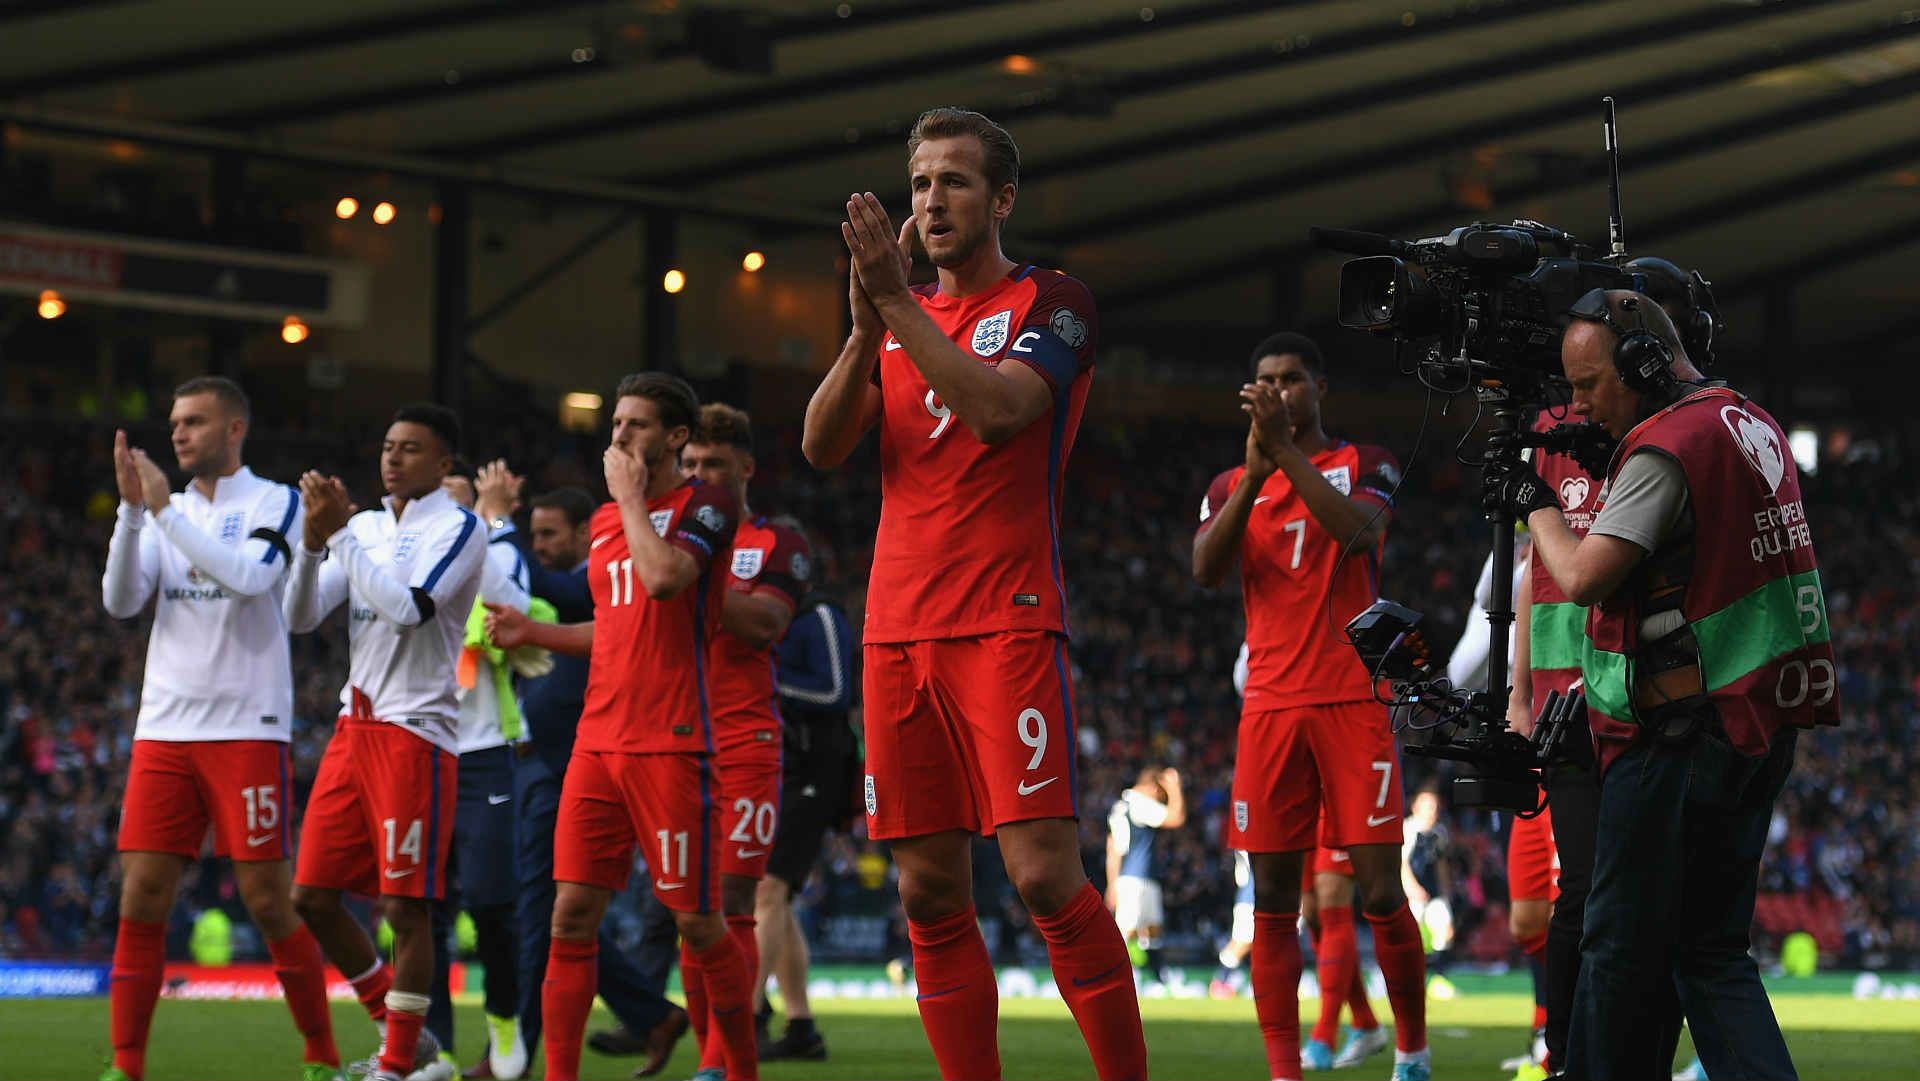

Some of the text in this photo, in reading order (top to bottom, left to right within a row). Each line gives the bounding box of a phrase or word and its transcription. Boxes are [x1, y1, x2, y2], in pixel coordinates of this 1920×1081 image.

[1012, 331, 1041, 352] C
[924, 388, 951, 439] 9
[1284, 519, 1306, 569] 7
[607, 558, 633, 607] 11
[1017, 708, 1048, 770] 9
[242, 785, 279, 831] 15
[1372, 761, 1393, 808] 7
[383, 818, 424, 864] 14
[729, 797, 776, 846] 20
[656, 829, 688, 877] 11
